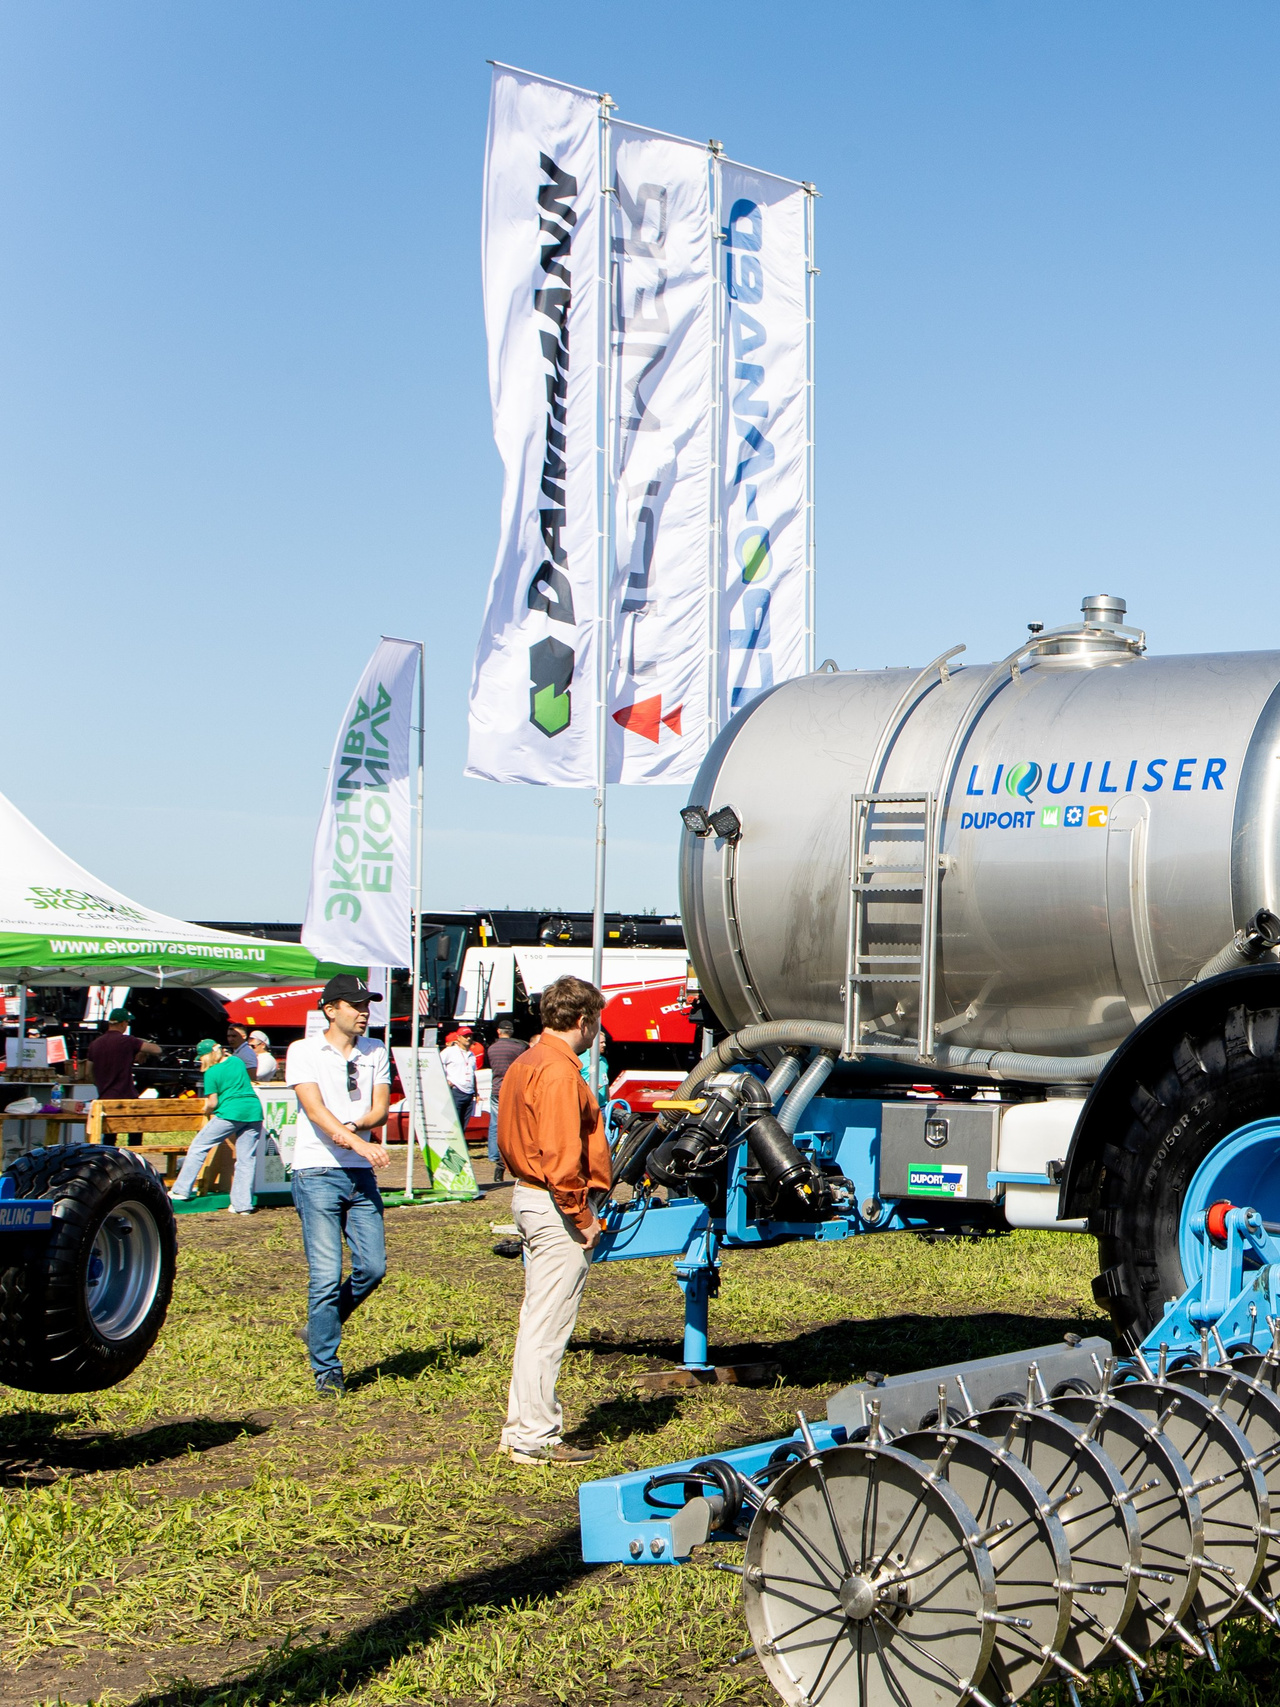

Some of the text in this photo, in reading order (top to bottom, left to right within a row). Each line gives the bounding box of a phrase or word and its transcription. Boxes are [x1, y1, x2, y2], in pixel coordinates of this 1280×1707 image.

[527, 150, 578, 626] DAMMANN
[965, 757, 1228, 804] LIQUILISER
[960, 810, 1036, 830] DUPORT
[50, 939, 266, 962] www.ekonivasemena.ru
[910, 1173, 944, 1185] DUPORT
